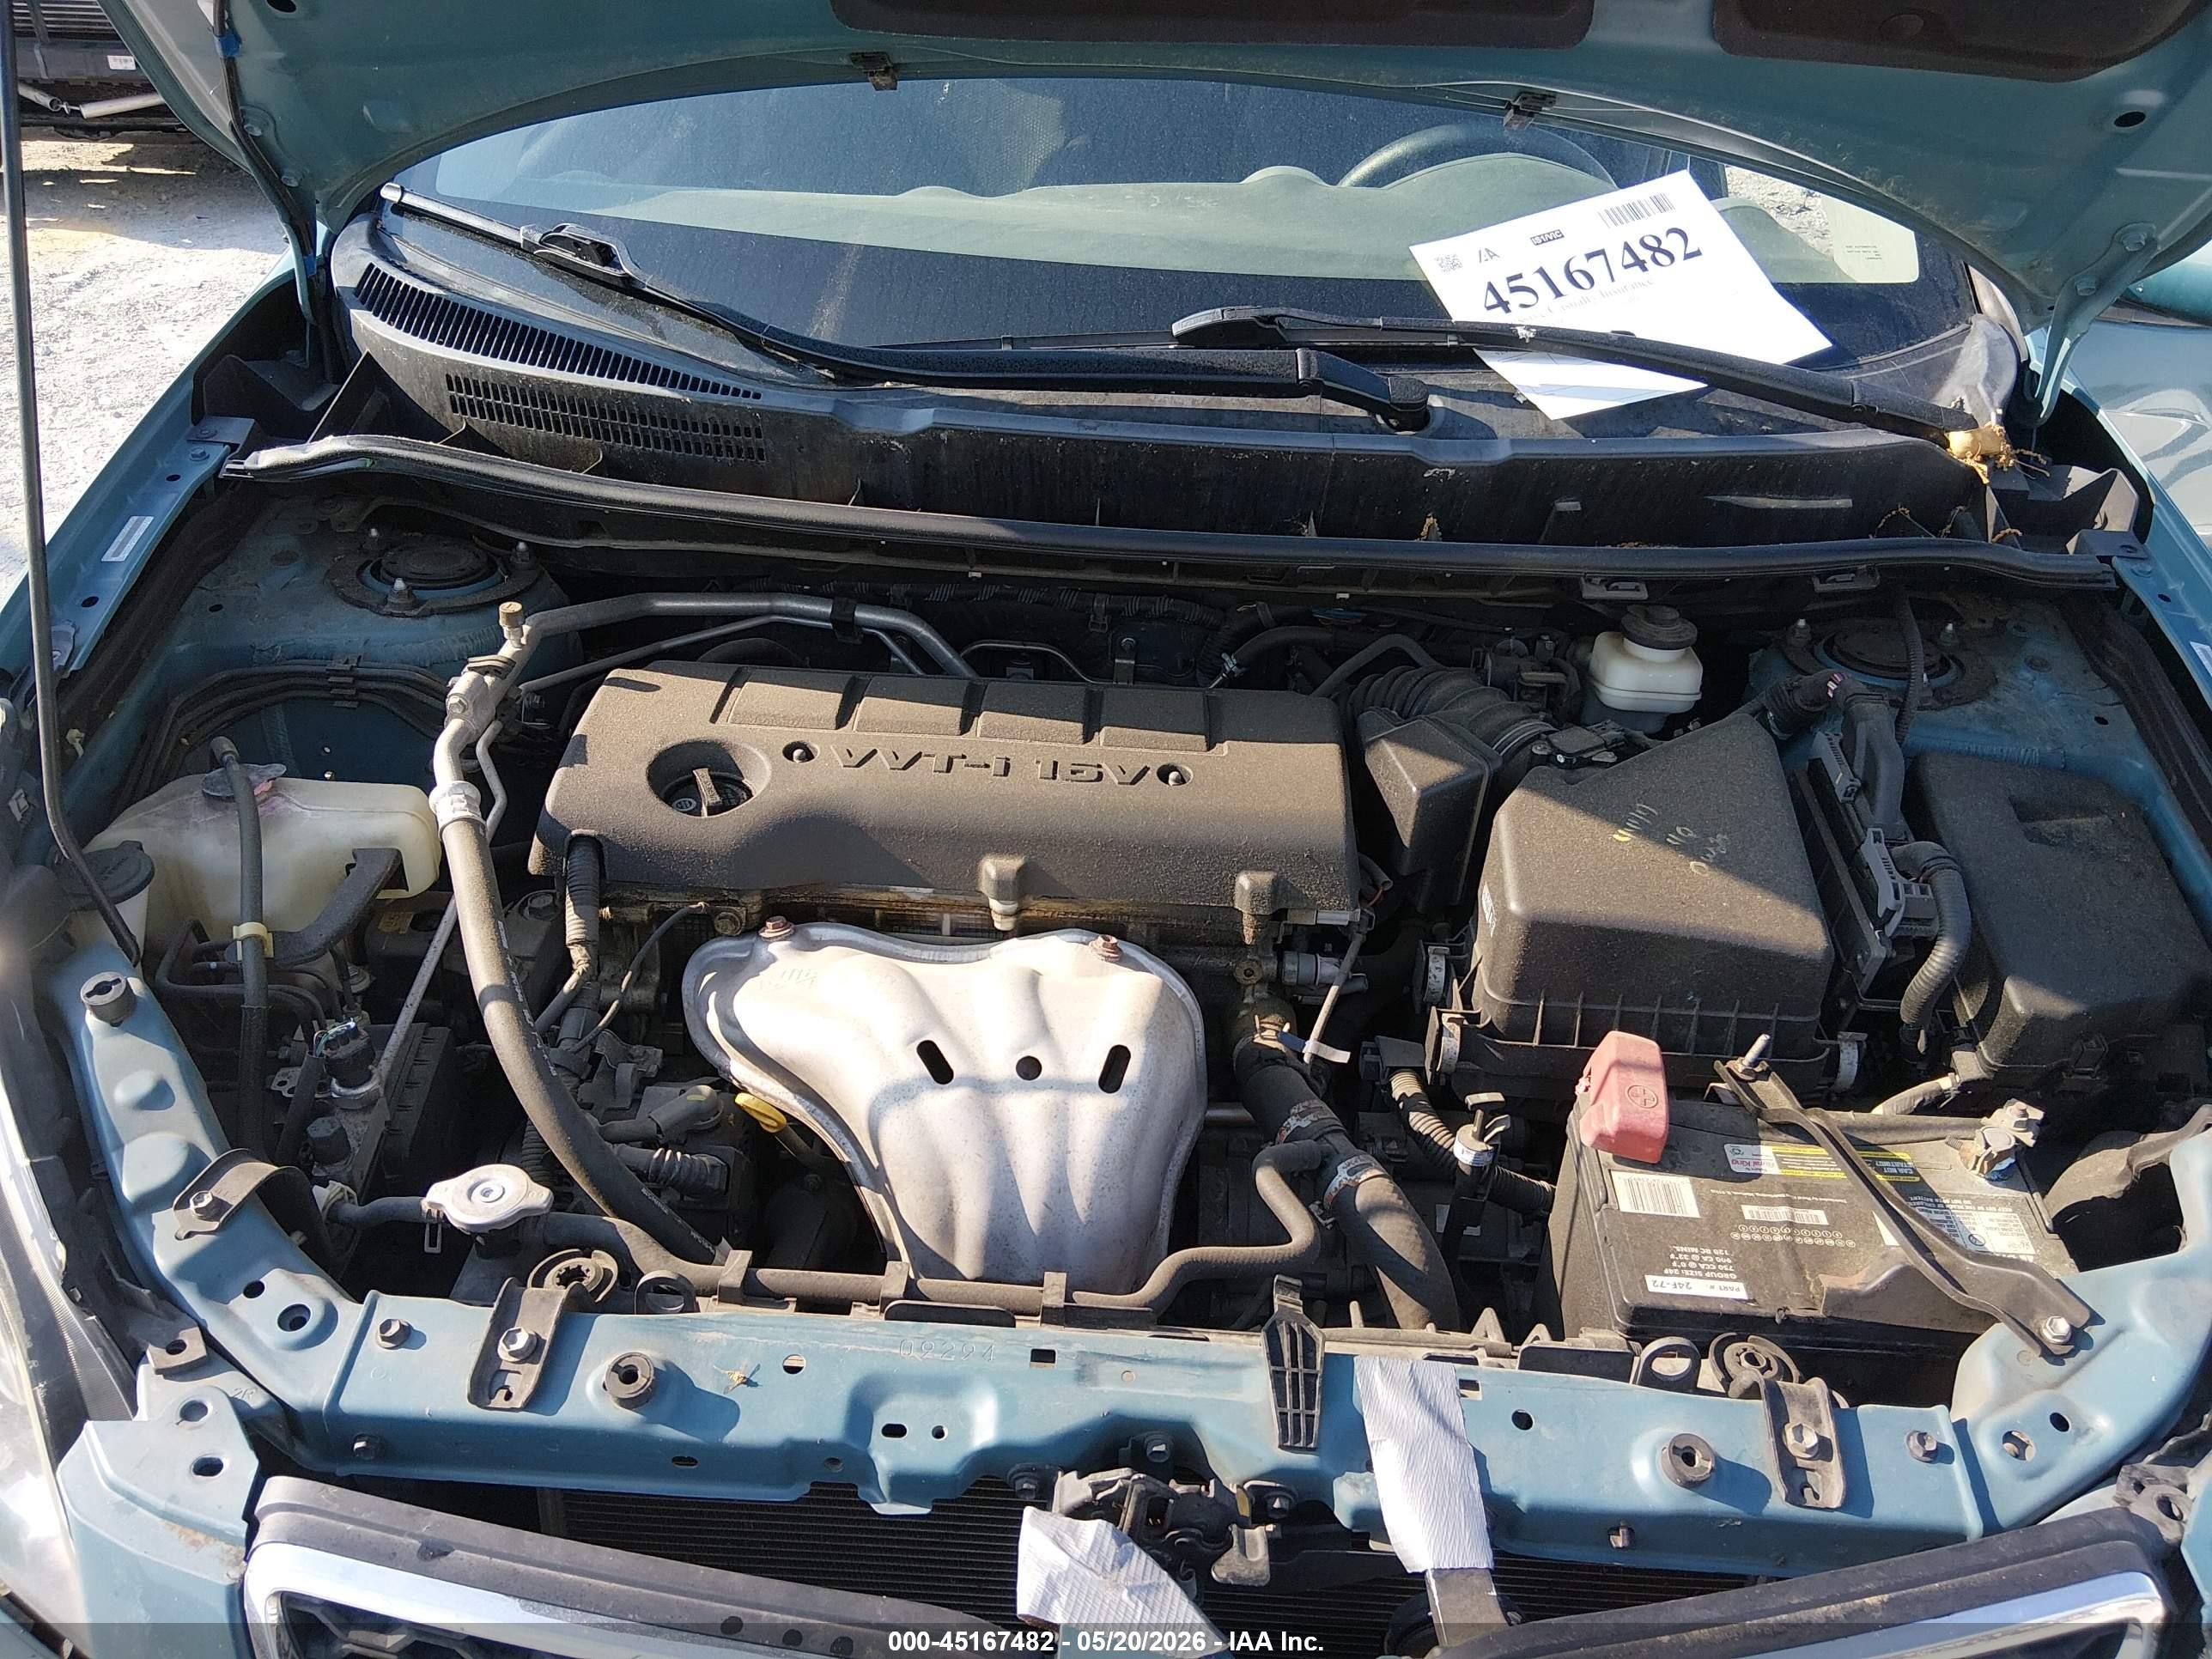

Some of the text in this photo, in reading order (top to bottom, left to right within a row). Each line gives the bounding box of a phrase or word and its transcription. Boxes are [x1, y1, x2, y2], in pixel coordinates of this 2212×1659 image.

[1484, 227, 1703, 314] 45167482
[1035, 757, 1151, 787] 16V
[1652, 1279, 1692, 1290] 24F-72
